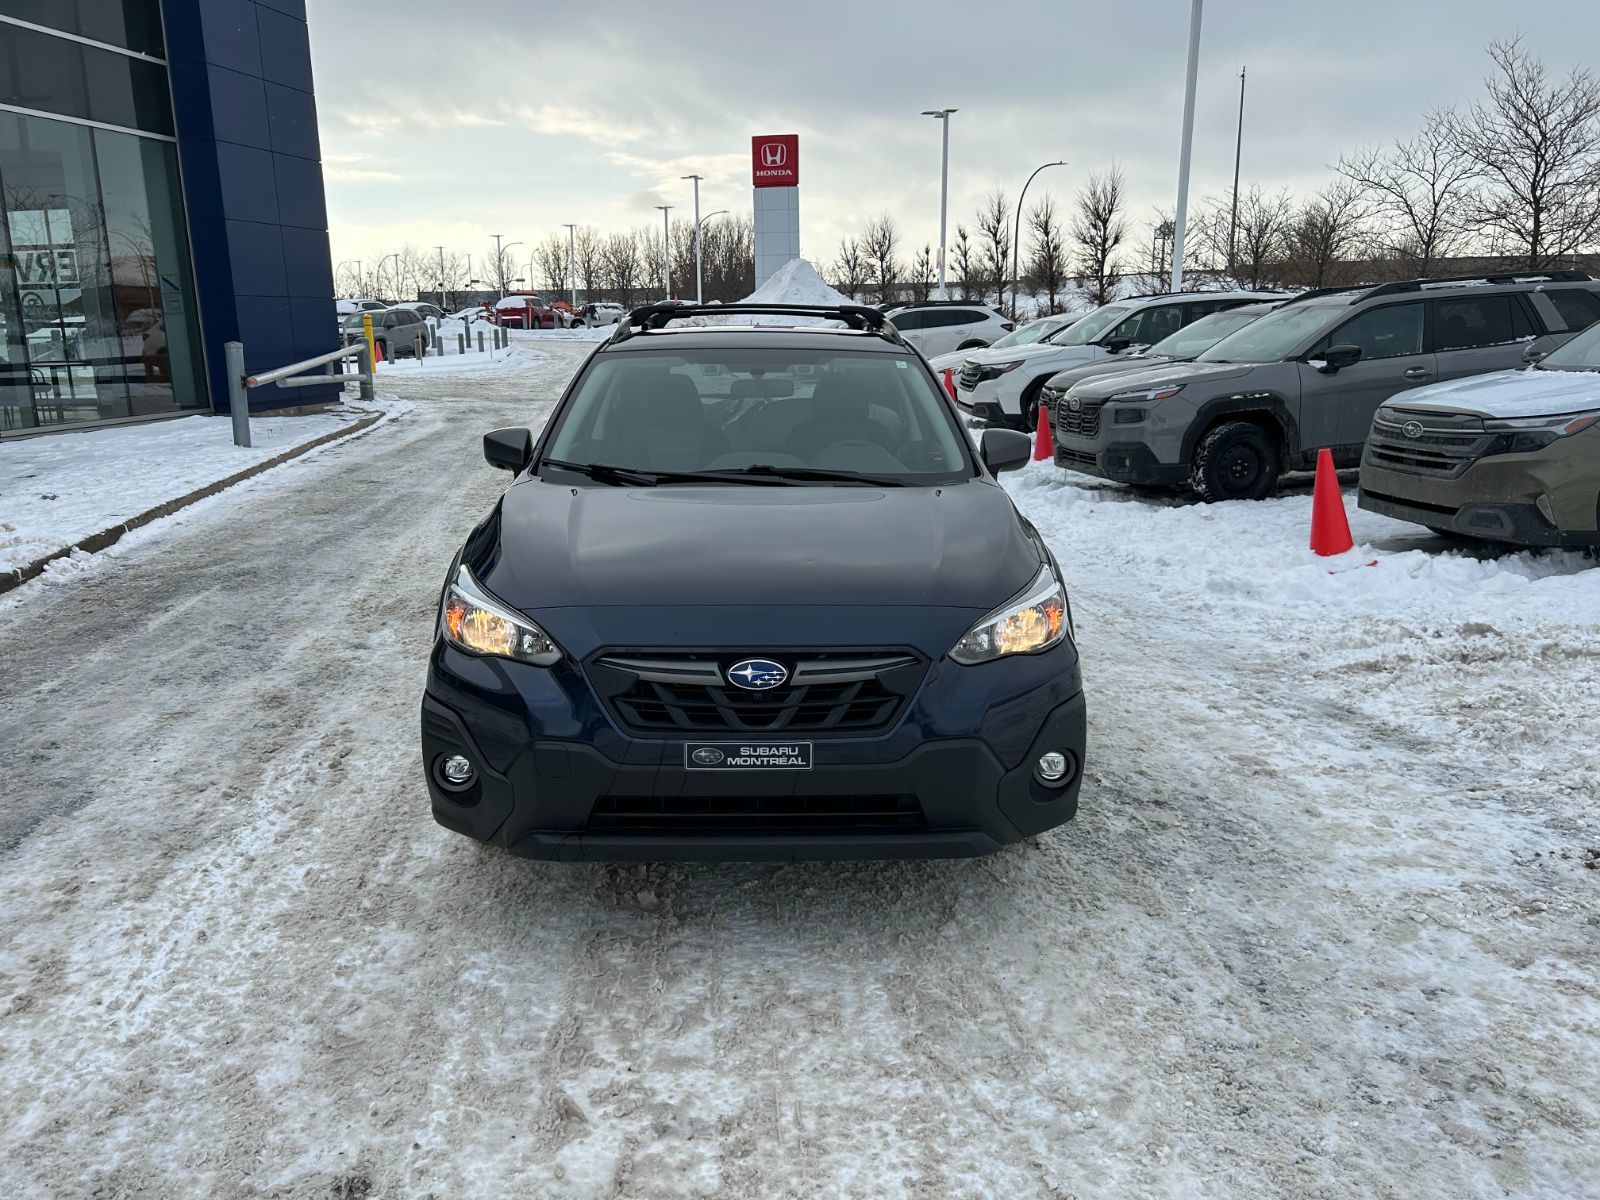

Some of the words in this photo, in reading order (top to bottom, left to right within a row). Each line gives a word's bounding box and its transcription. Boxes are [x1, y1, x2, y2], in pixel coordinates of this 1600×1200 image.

[756, 169, 793, 177] HONDA
[739, 747, 799, 756] SUBARU
[727, 755, 806, 765] MONTRÉAL
